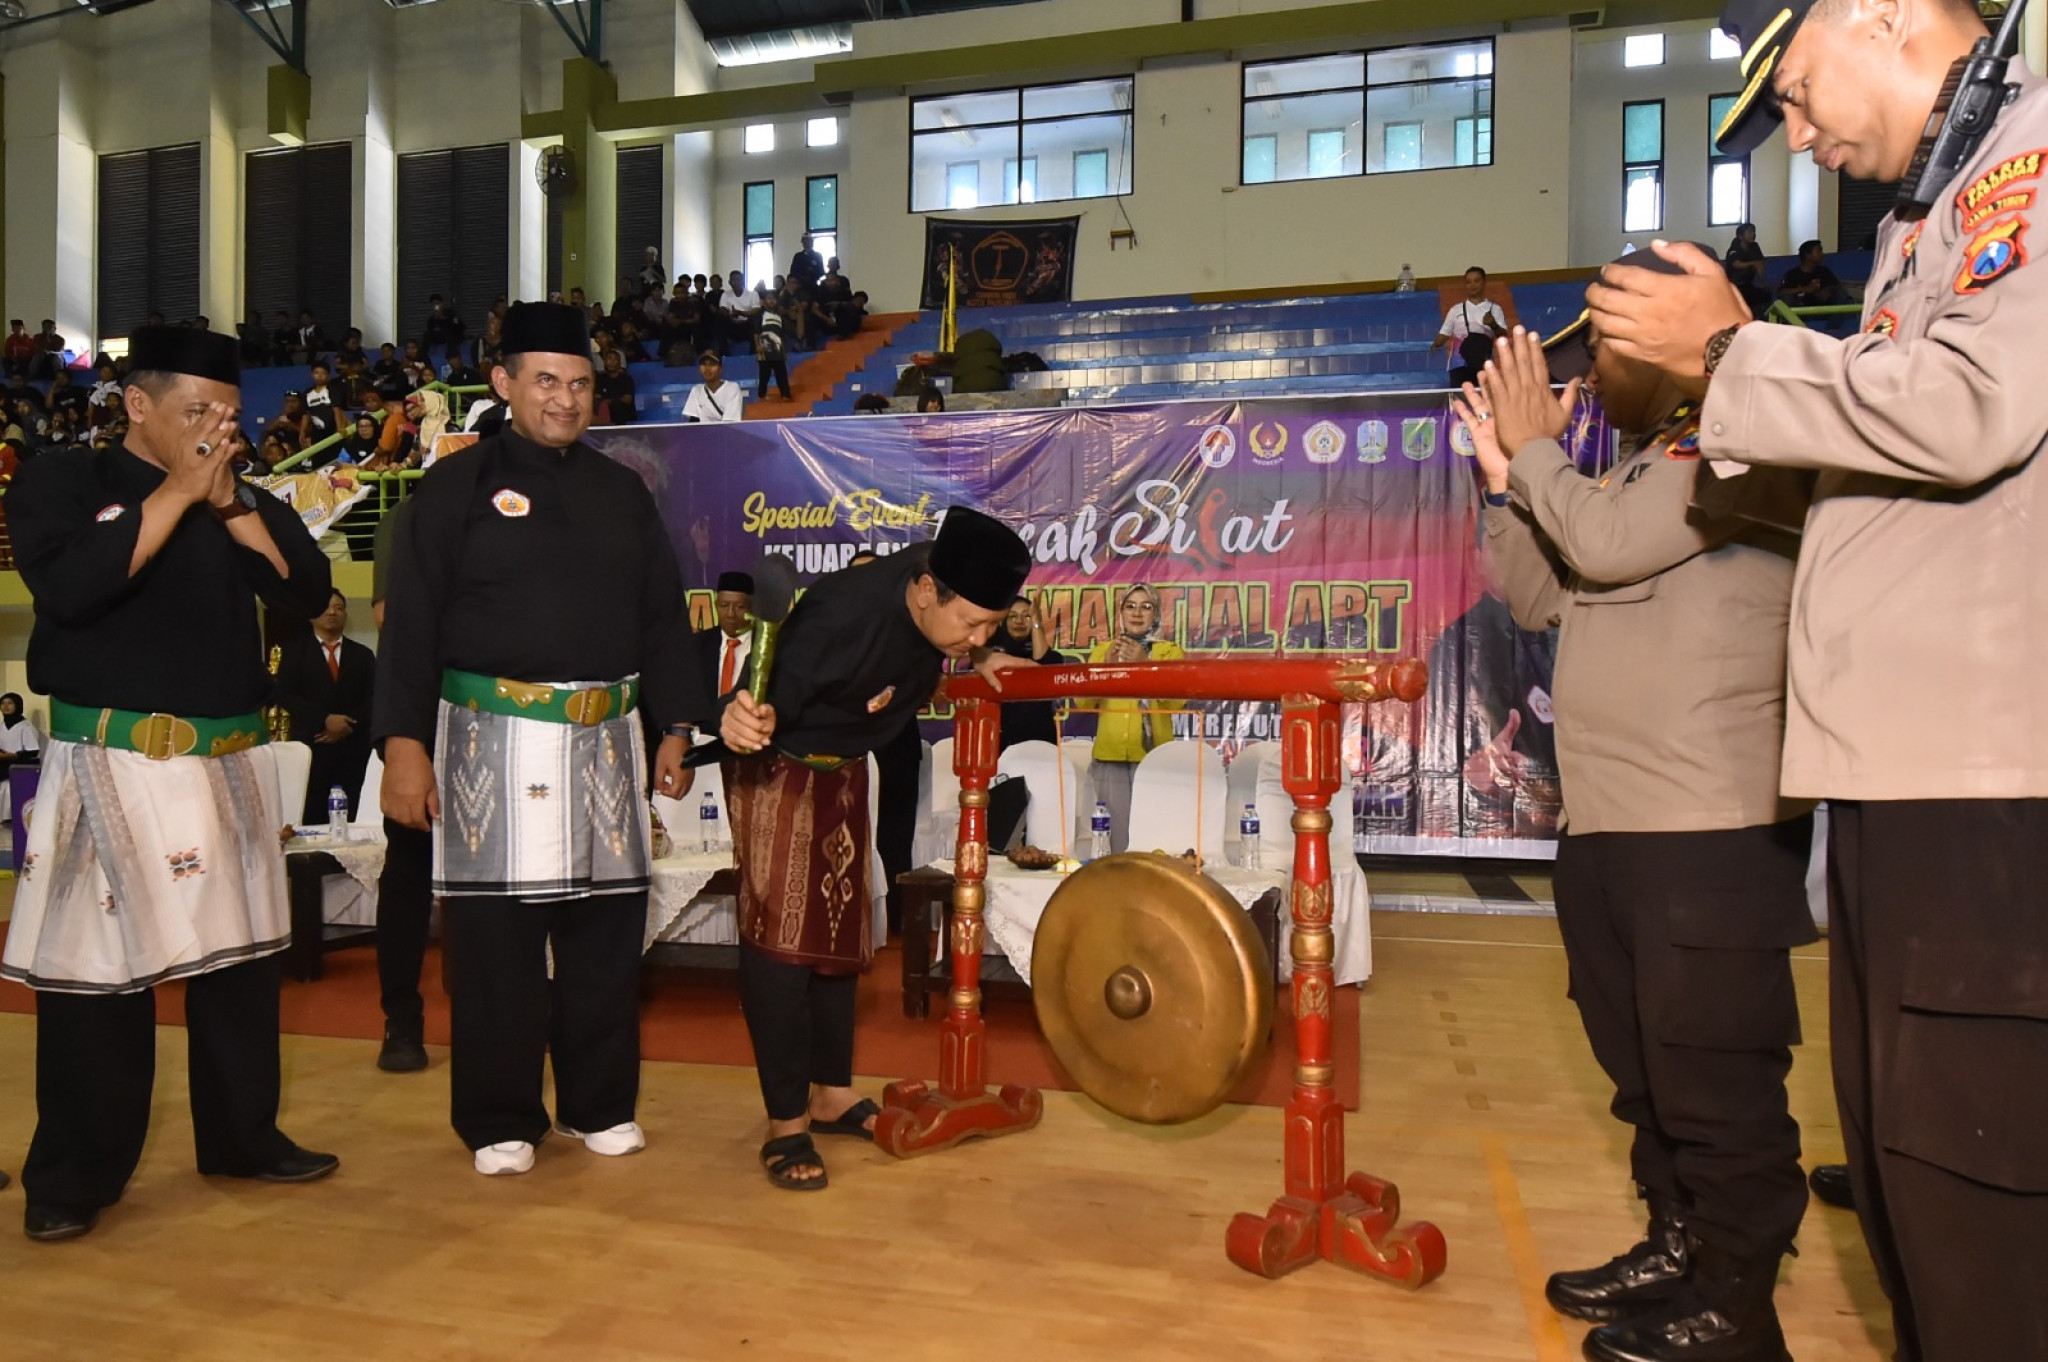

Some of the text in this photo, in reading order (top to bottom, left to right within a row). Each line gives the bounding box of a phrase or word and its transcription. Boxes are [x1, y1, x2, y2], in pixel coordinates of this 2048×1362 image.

[743, 488, 931, 538] Spesial Event
[764, 542, 910, 574] EJUARA
[1028, 580, 1412, 653] MATIAL ART
[1173, 713, 1282, 737] MEREBUT
